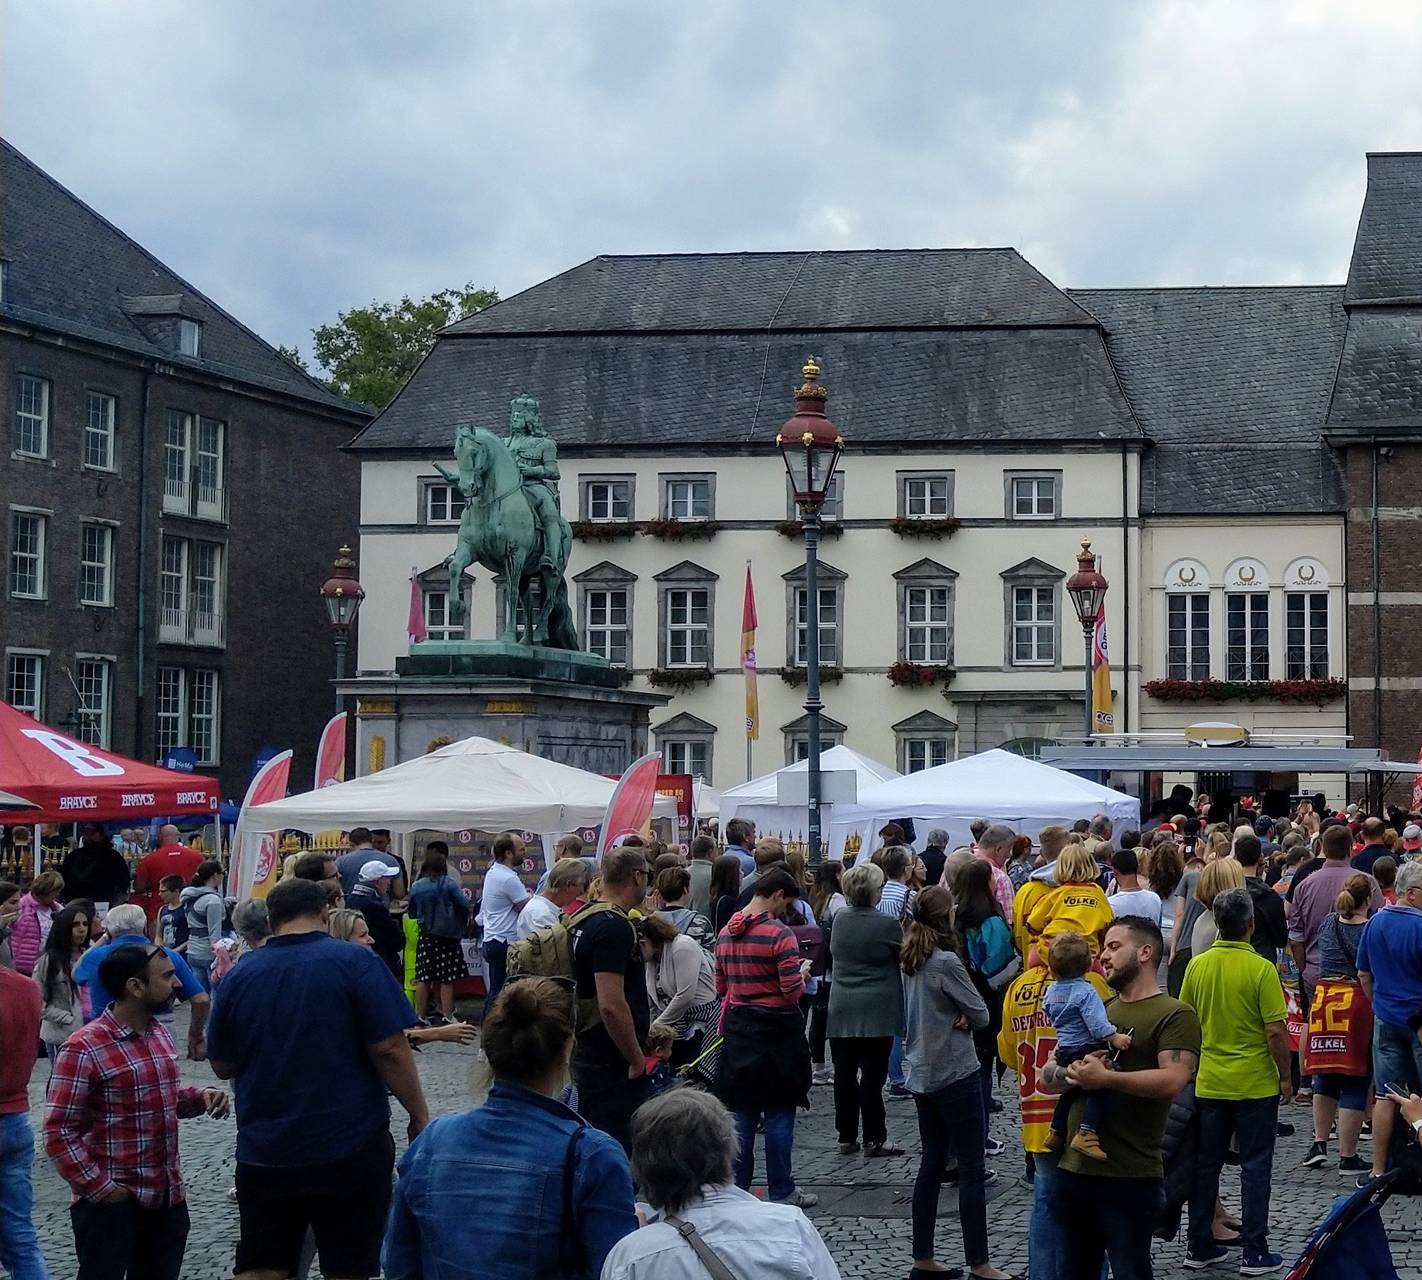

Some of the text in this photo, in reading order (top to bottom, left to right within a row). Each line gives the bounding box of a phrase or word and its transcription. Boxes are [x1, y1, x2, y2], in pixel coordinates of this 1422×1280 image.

[19, 728, 126, 777] B
[59, 791, 207, 810] BRAYCE BRAYCE BRAYCE
[1309, 984, 1354, 1033] 22
